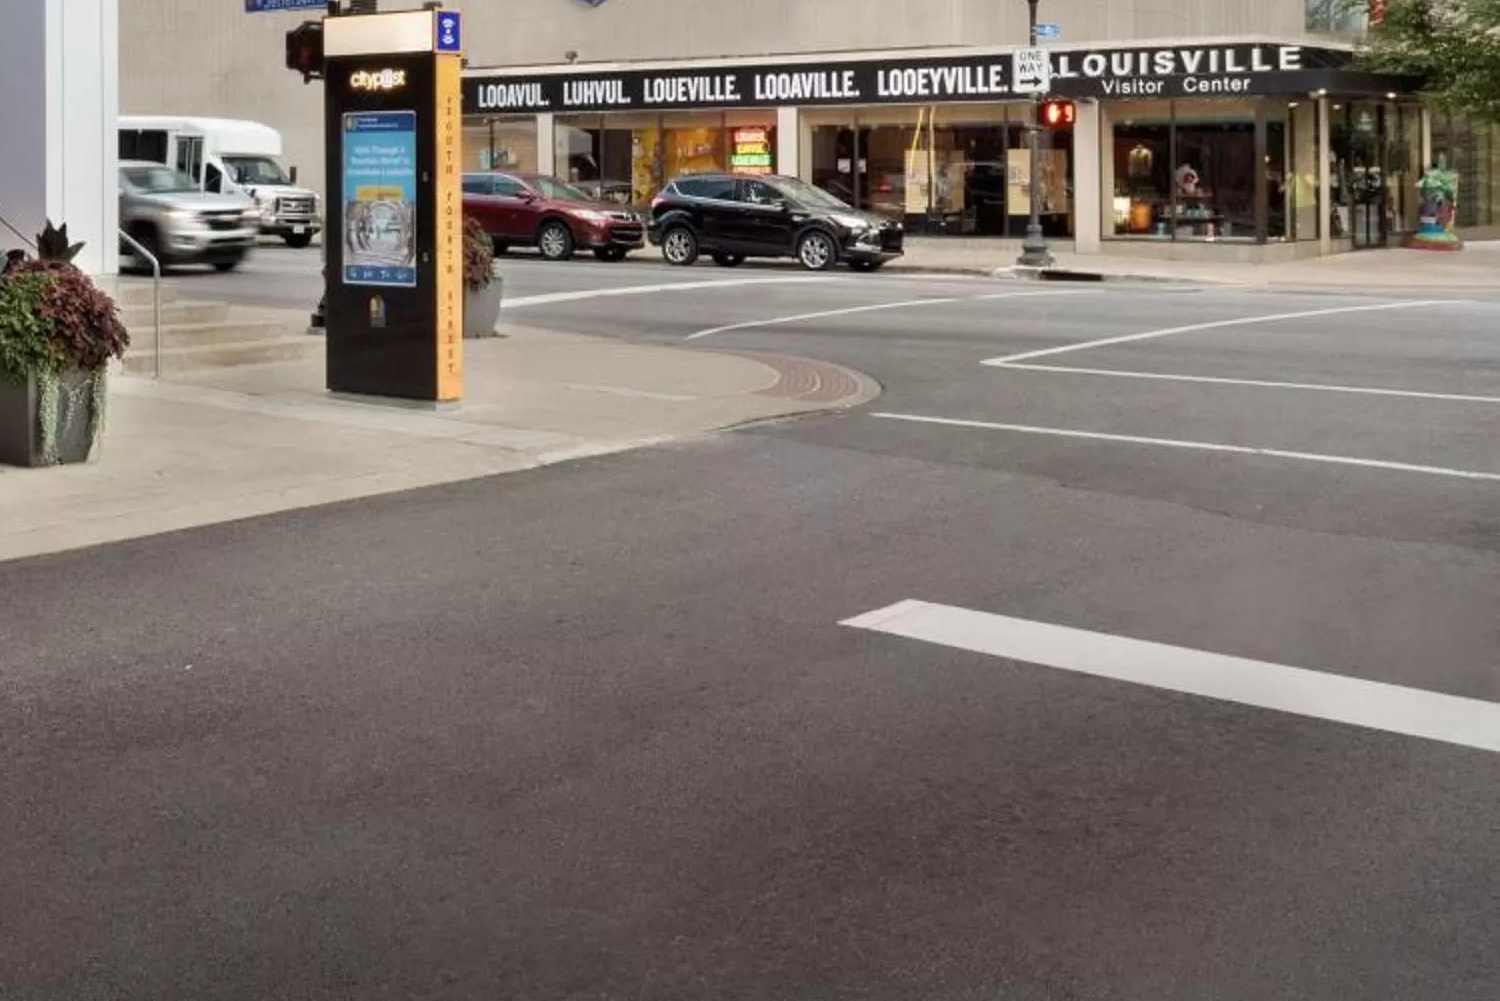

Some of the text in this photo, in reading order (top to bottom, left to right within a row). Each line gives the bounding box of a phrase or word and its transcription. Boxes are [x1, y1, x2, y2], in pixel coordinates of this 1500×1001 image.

[1019, 51, 1041, 60] ONE
[1059, 47, 1301, 78] LOUISVILLE
[1019, 63, 1043, 73] WAY
[563, 79, 631, 105] LUHVUL.
[644, 76, 740, 103] LOUEVILLE.
[755, 71, 860, 100] LOOAVILLE.
[877, 65, 1008, 96] LOOEYVILLE.
[1101, 76, 1251, 95] Visitor Center
